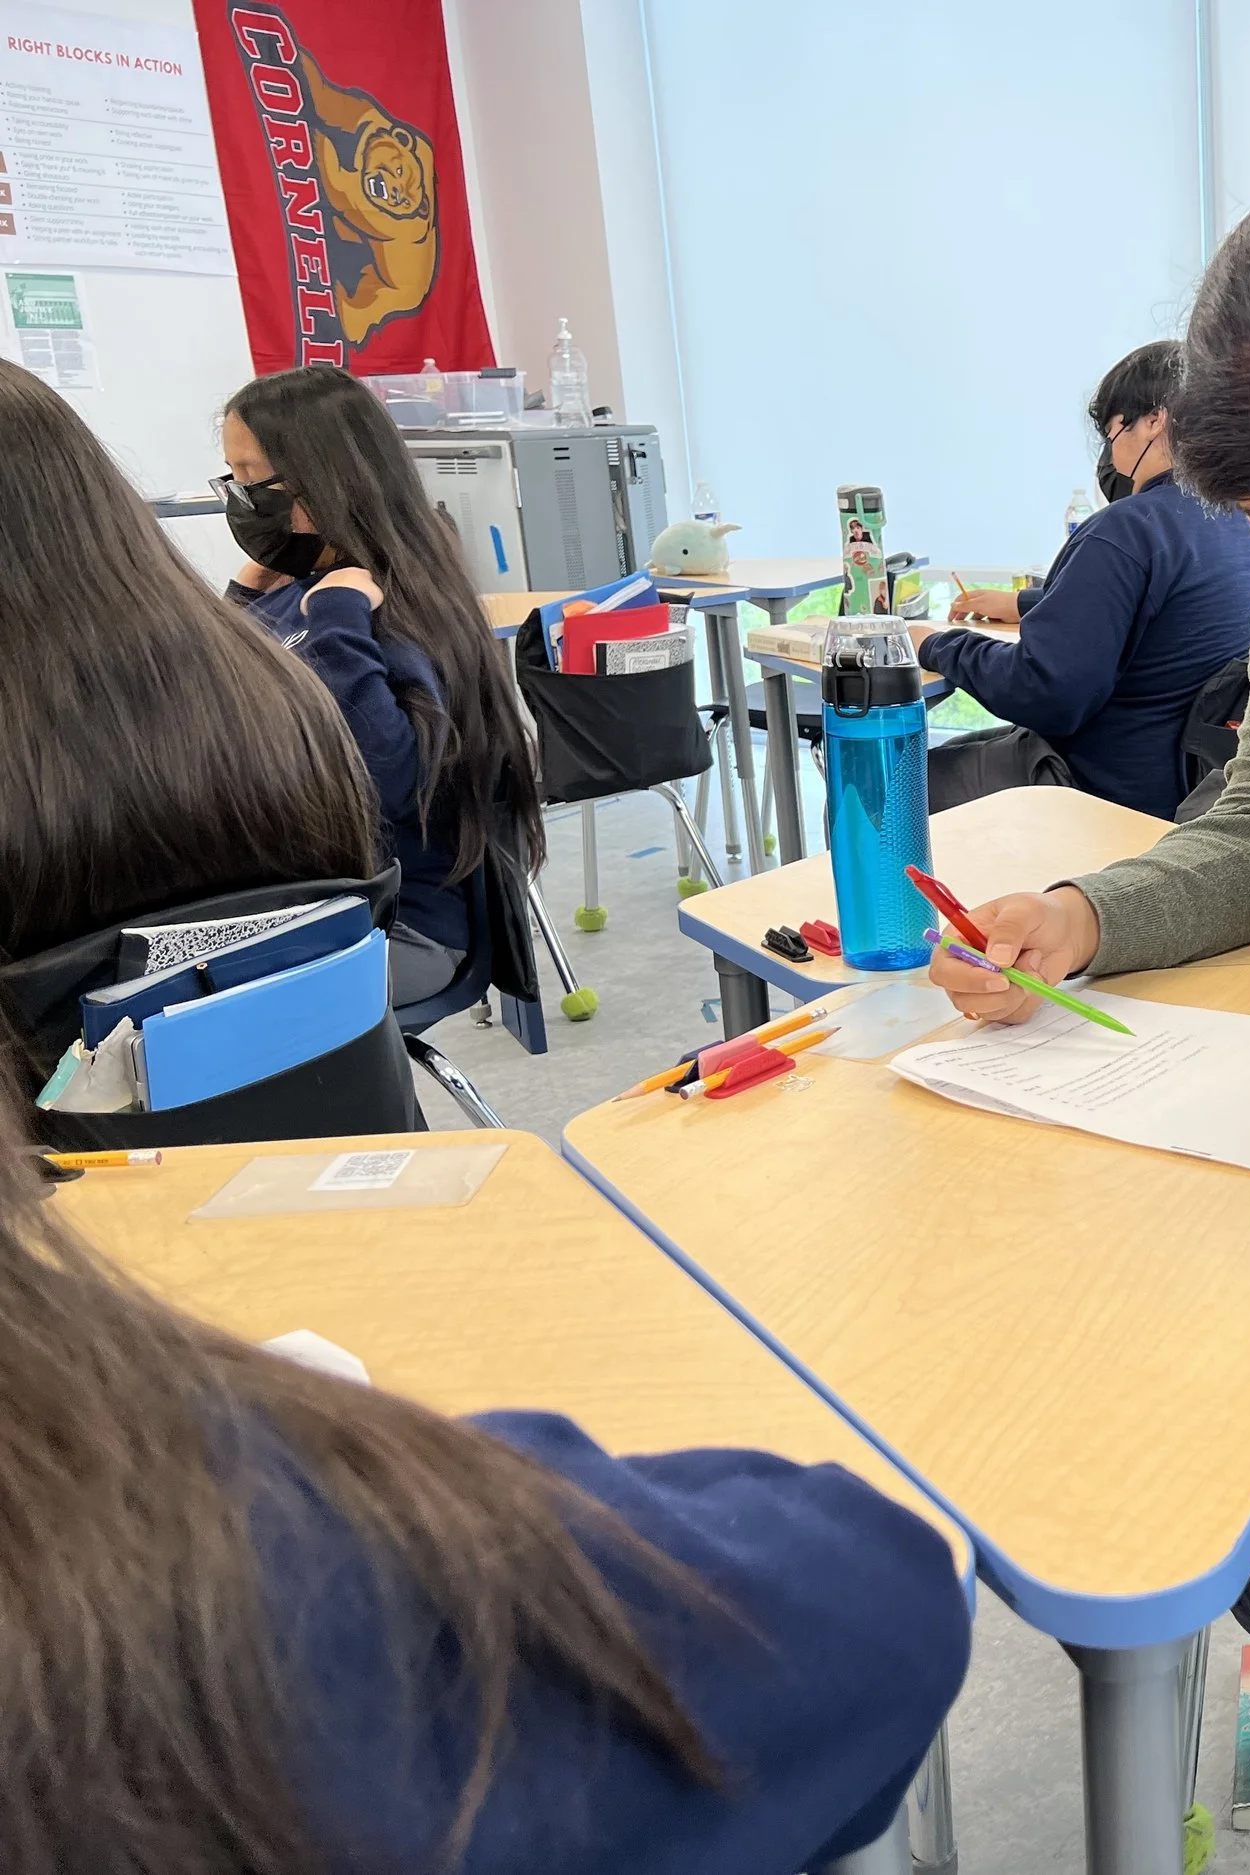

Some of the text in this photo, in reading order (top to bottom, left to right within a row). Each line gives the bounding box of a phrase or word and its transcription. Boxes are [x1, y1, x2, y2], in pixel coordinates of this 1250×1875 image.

[7, 36, 183, 76] RIGHT BLOCKS IN ACTION
